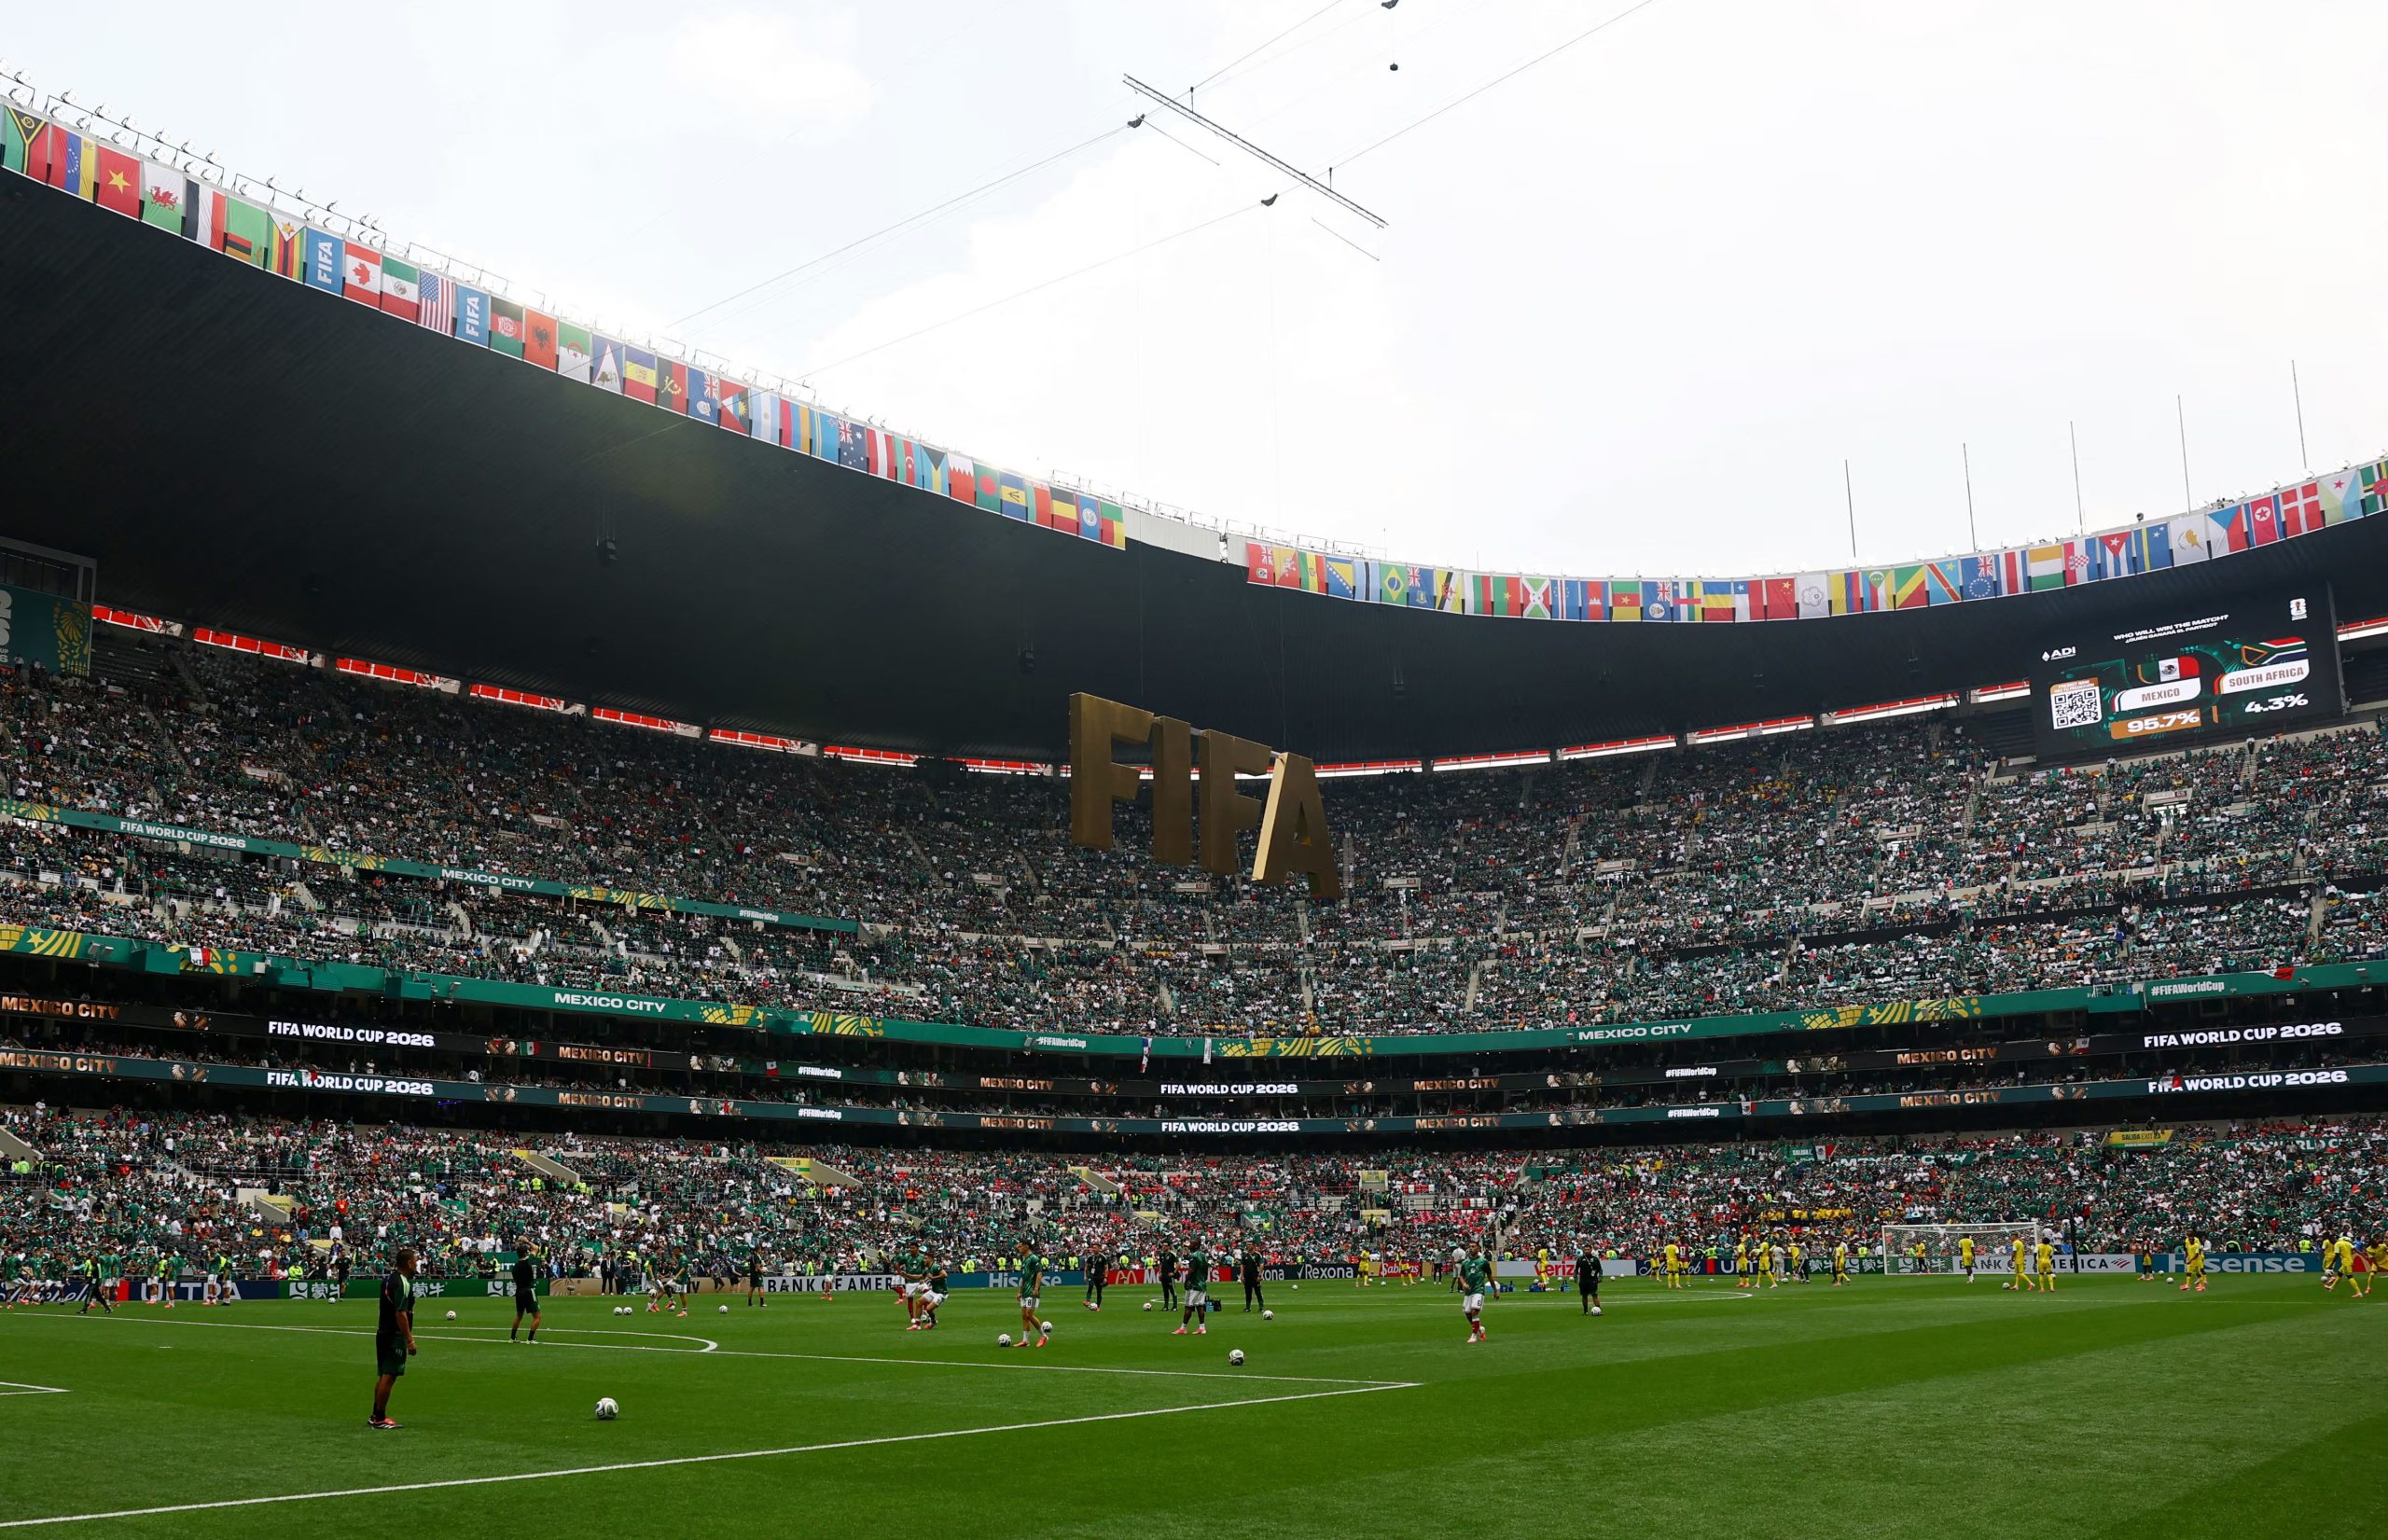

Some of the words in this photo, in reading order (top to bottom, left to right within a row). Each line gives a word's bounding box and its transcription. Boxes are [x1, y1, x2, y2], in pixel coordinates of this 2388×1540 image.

[317, 241, 333, 284] FIFA
[466, 297, 479, 337] FIFA
[2113, 631, 2134, 641] WHO
[2134, 629, 2156, 637] WILL
[2191, 614, 2229, 626] MATCH?
[2147, 630, 2177, 638] GANARÁ
[2185, 622, 2218, 631] PARTIDO?
[2051, 645, 2076, 658] ADI
[2228, 673, 2264, 688] SOUTH
[2265, 666, 2304, 683] AFRICA
[2141, 687, 2180, 702] MEXICO
[2244, 693, 2309, 714] 4.3%
[2127, 710, 2201, 733] 95.7%
[1069, 692, 1344, 899] FIFA
[119, 821, 146, 834] FIFA
[146, 825, 186, 839] WORLD
[187, 829, 208, 841] CUP
[209, 835, 246, 849] 2026
[441, 868, 499, 886] MEXICO
[500, 877, 535, 890] CITY
[739, 909, 780, 923] #FIFAWorldCup
[2151, 981, 2225, 996] #FIFAWorldCup
[1, 996, 74, 1017] MEXICO
[77, 1003, 120, 1020] CITY
[554, 992, 624, 1010] MEXICO
[626, 999, 666, 1013] CITY
[268, 1020, 300, 1037] FIFA
[301, 1024, 354, 1040] WORLD
[355, 1029, 384, 1043] CUP
[385, 1032, 435, 1047] 2026
[1578, 1027, 1648, 1041] MEXICO
[1650, 1023, 1692, 1036] CITY
[2144, 1034, 2178, 1048] FIFA
[2180, 1030, 2241, 1045] WORLD
[2242, 1027, 2278, 1041] CUP
[2280, 1021, 2342, 1038] 2026
[1038, 1036, 1087, 1049] #FIFAWorldCup
[0, 1051, 72, 1072] MEXICO
[75, 1057, 118, 1074] CITY
[559, 1046, 612, 1062] MEXICO
[613, 1050, 645, 1064] CITY
[1896, 1050, 1958, 1064] MEXICO
[1960, 1047, 1998, 1061] CITY
[798, 1065, 842, 1079] #FIFAWorldCup
[1665, 1066, 1717, 1079] #FIFAWorldCup
[2185, 1076, 2245, 1091] WORLD
[2247, 1074, 2283, 1088] CUP
[2284, 1070, 2348, 1086] 2026
[267, 1072, 299, 1087] FIFA
[354, 1078, 383, 1092] CUP
[384, 1081, 434, 1095] 2026
[979, 1076, 1024, 1090] MEXICO
[1026, 1078, 1055, 1091] CITY
[1160, 1084, 1186, 1095] FIFA
[1187, 1084, 1231, 1095] WORLD
[1232, 1084, 1255, 1095] CUP
[1256, 1083, 1298, 1094] 2026
[1413, 1078, 1466, 1090] MEXICO
[1467, 1077, 1500, 1089] CITY
[558, 1091, 612, 1108] MEXICO
[613, 1094, 645, 1109] CITY
[1900, 1093, 1961, 1107] MEXICO
[1964, 1090, 2001, 1104] CITY
[798, 1108, 842, 1120] #FIFAWorldCup
[1668, 1107, 1719, 1119] #FIFAWorldCup
[979, 1117, 1024, 1130] MEXICO
[1026, 1118, 1055, 1130] CITY
[1161, 1121, 1187, 1132] FIFA
[1187, 1121, 1232, 1132] WORLD
[1233, 1121, 1256, 1132] CUP
[1256, 1120, 1299, 1132] 2026
[1415, 1117, 1467, 1129] MEXICO
[1469, 1116, 1501, 1128] CITY
[1306, 1264, 1353, 1279] Rexona
[2169, 1253, 2306, 1273] Hsense
[768, 1278, 816, 1292] BANK
[989, 1272, 1062, 1288] Hisse
[1027, 1298, 1032, 1307] 8
